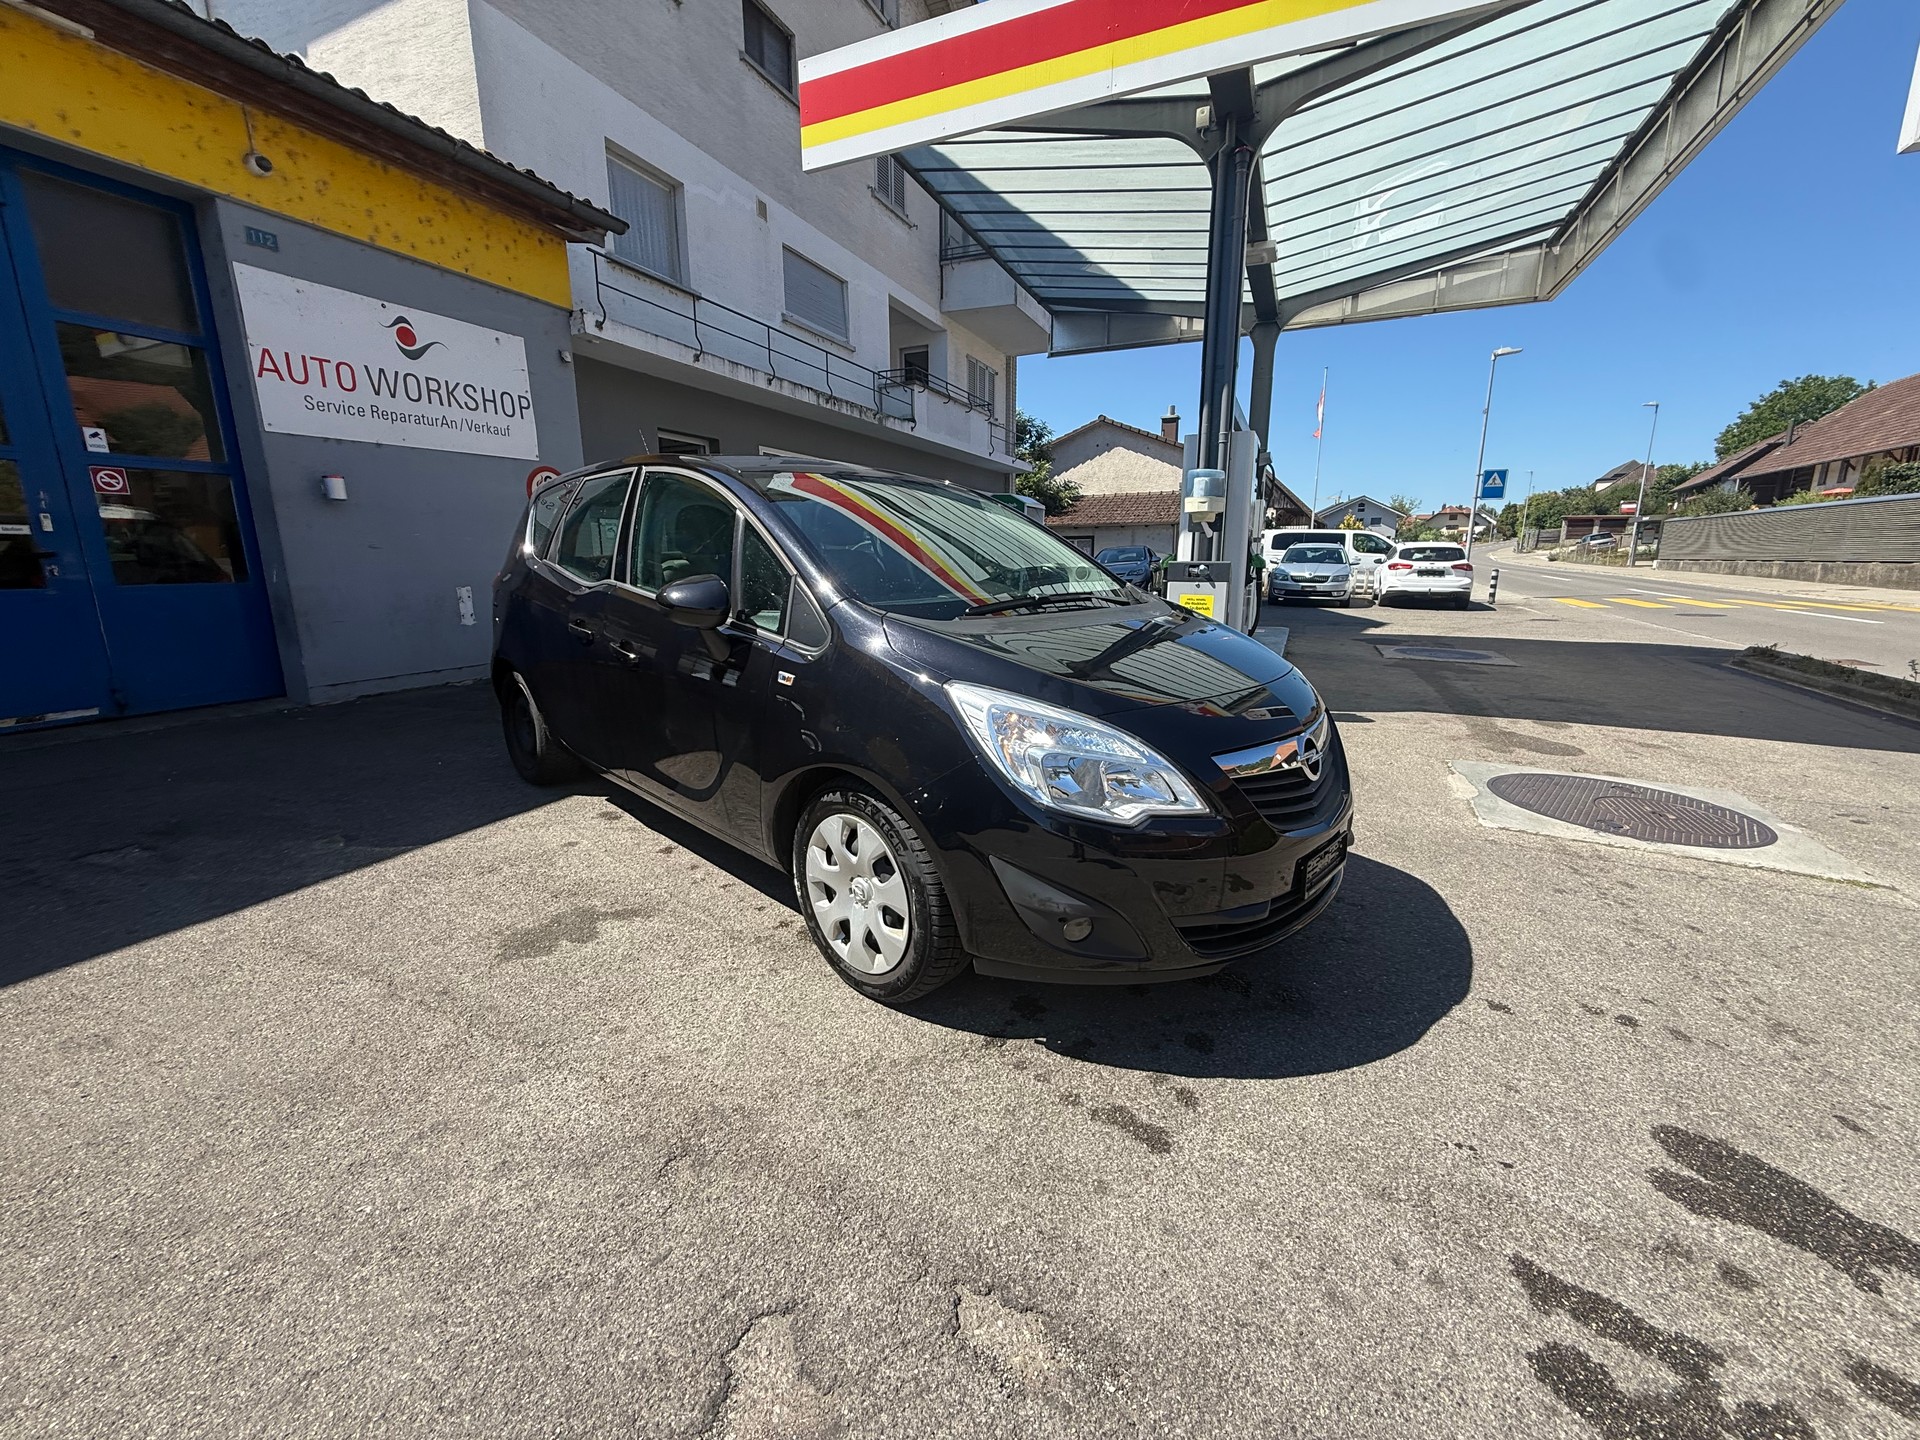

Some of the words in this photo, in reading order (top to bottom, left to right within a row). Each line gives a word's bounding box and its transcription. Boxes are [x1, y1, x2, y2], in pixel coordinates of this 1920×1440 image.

[250, 229, 275, 247] 112
[257, 347, 357, 393] AUTO
[363, 364, 531, 420] WORKSHOP
[304, 394, 366, 417] Service
